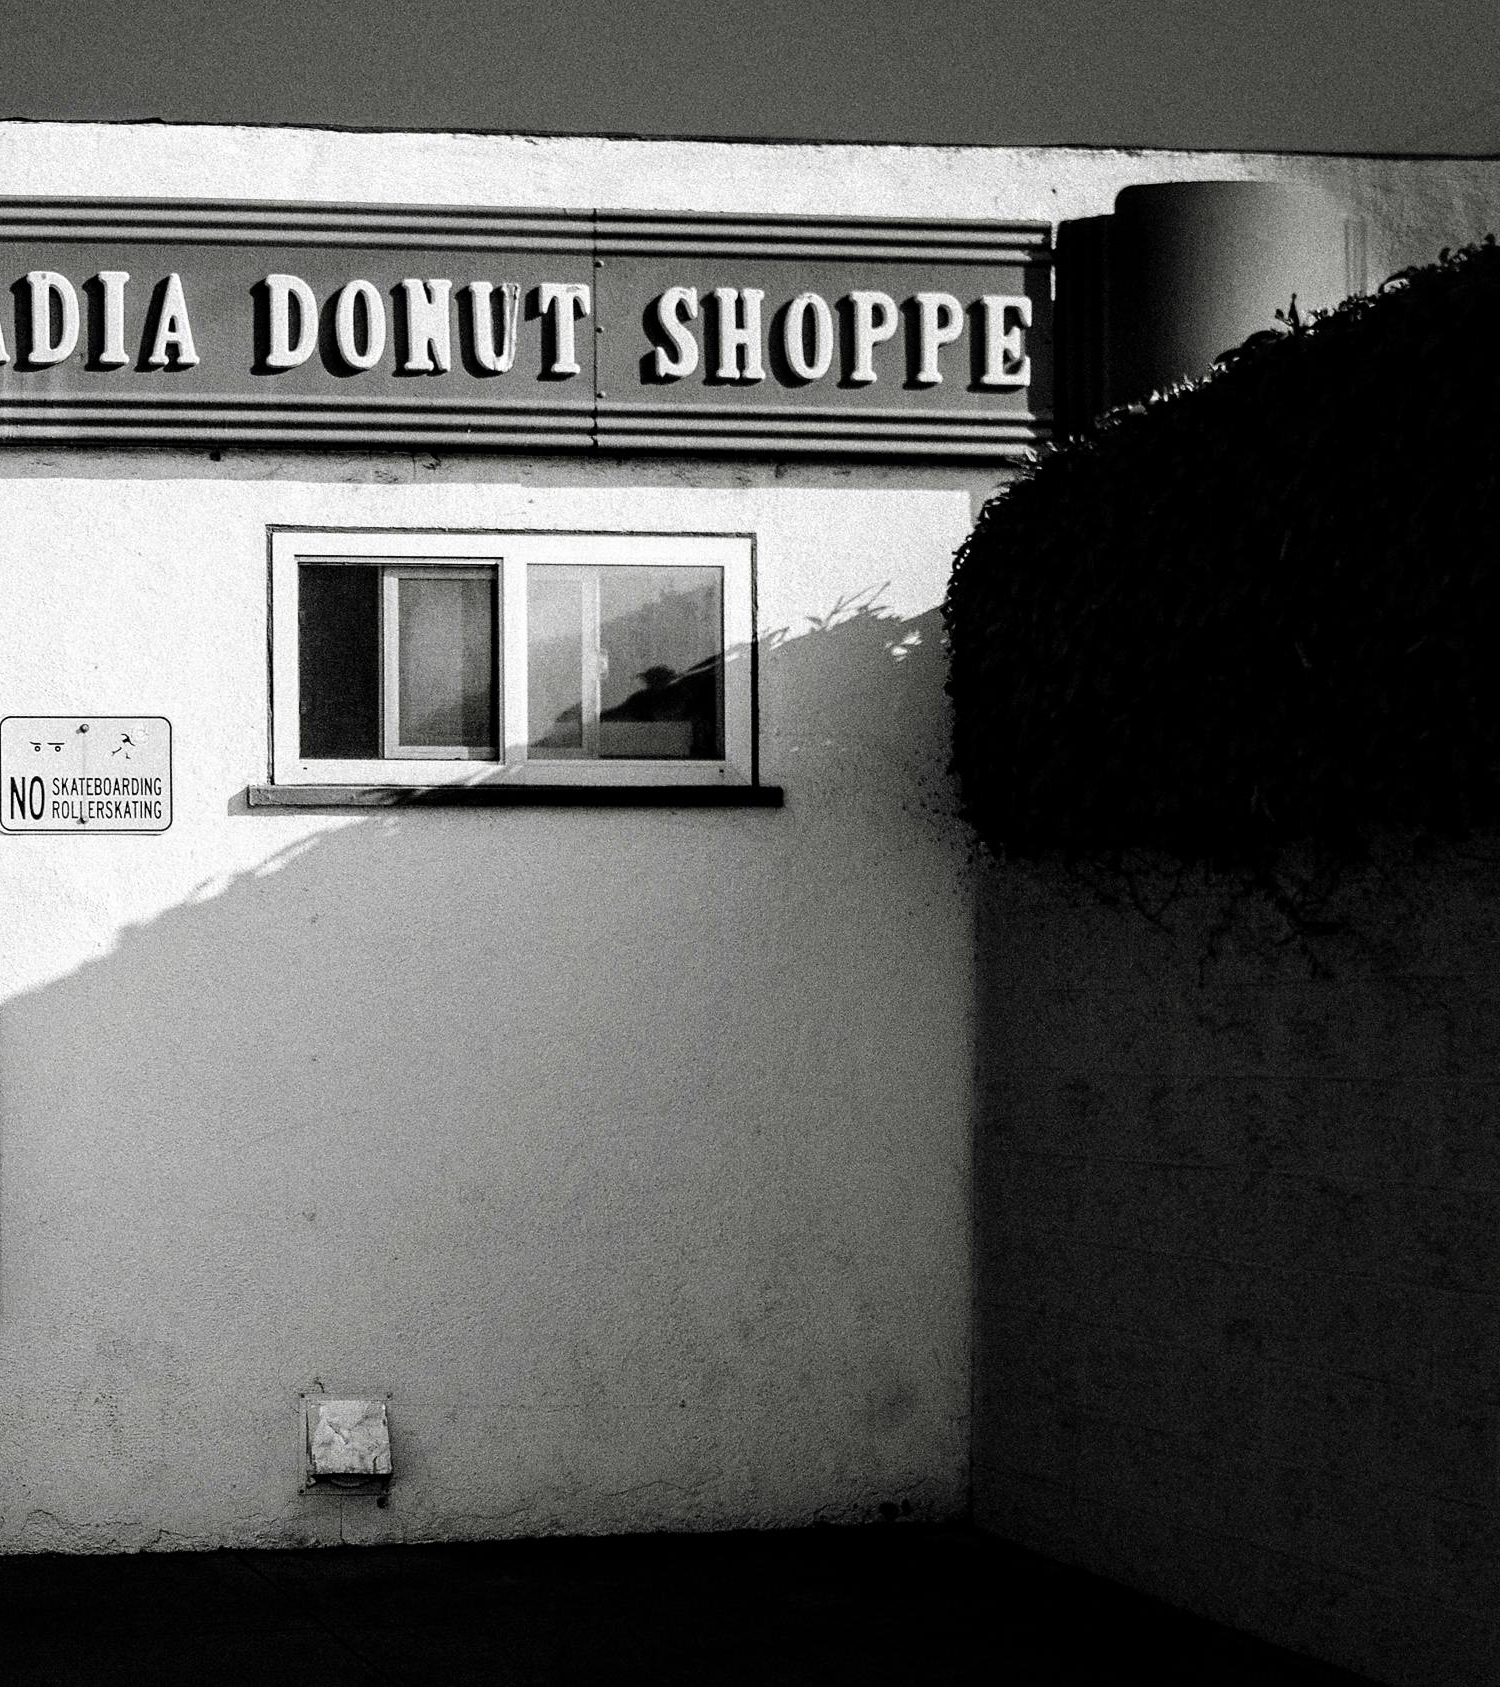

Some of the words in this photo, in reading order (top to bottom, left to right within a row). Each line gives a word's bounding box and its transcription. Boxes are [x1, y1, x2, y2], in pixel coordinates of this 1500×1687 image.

[265, 274, 592, 375] DONUT
[655, 286, 1032, 386] SHOPPE
[10, 775, 46, 821] NO
[52, 777, 162, 796] SKATEBOARDING
[52, 800, 162, 819] ROLLERSKATING
